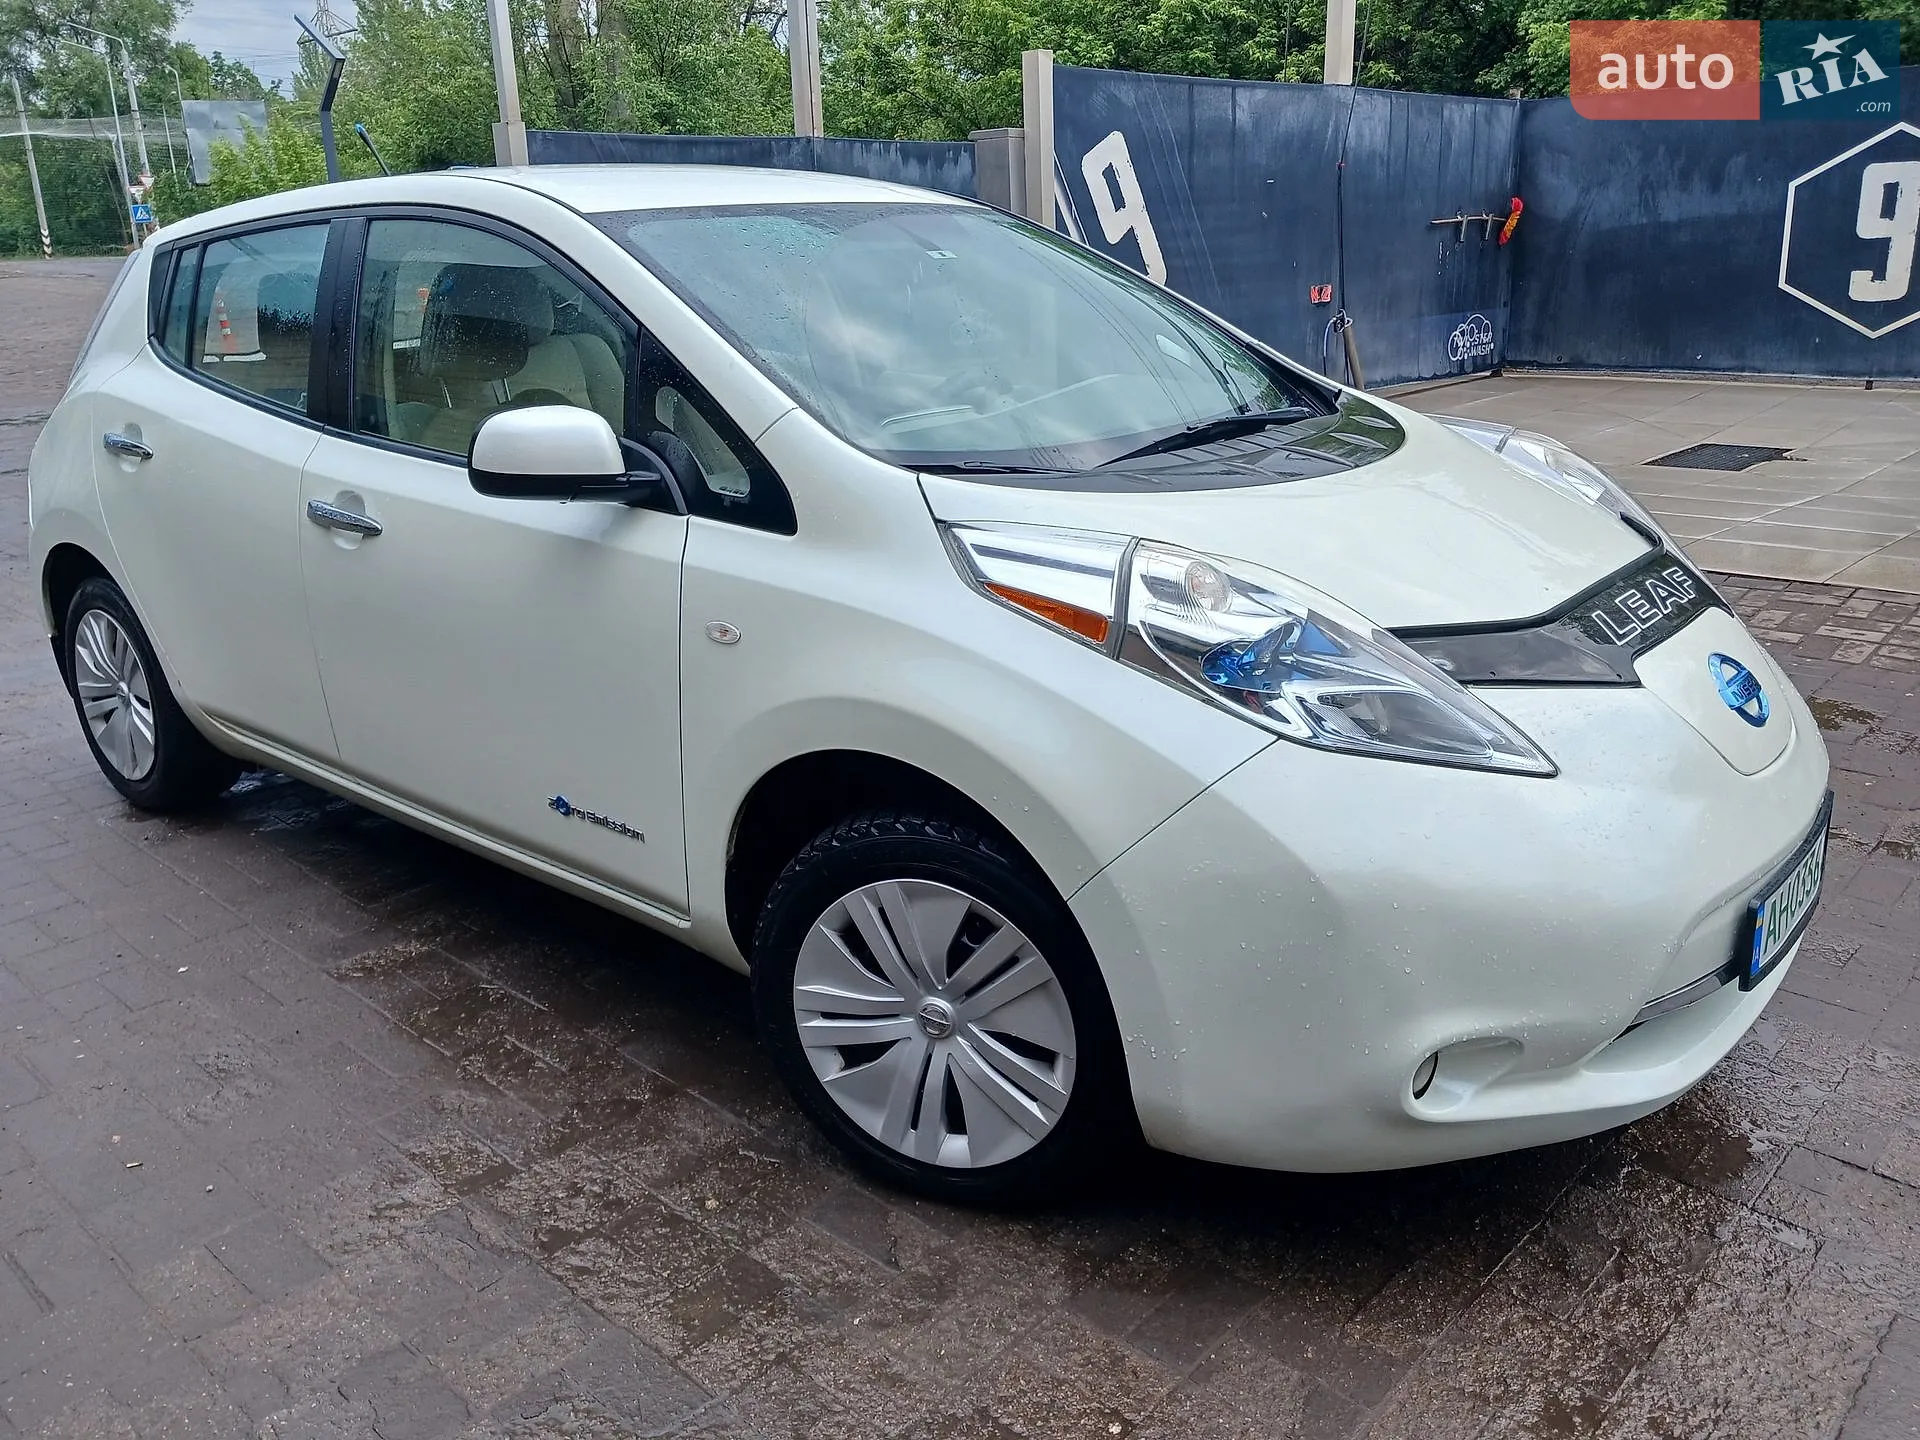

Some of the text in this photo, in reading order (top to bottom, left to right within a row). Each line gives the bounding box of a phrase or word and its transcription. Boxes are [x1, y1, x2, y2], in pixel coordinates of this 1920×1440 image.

[1081, 130, 1168, 286] 9
[1848, 161, 1920, 302] 9
[1591, 566, 1696, 646] LEAF
[586, 809, 646, 844] Emission
